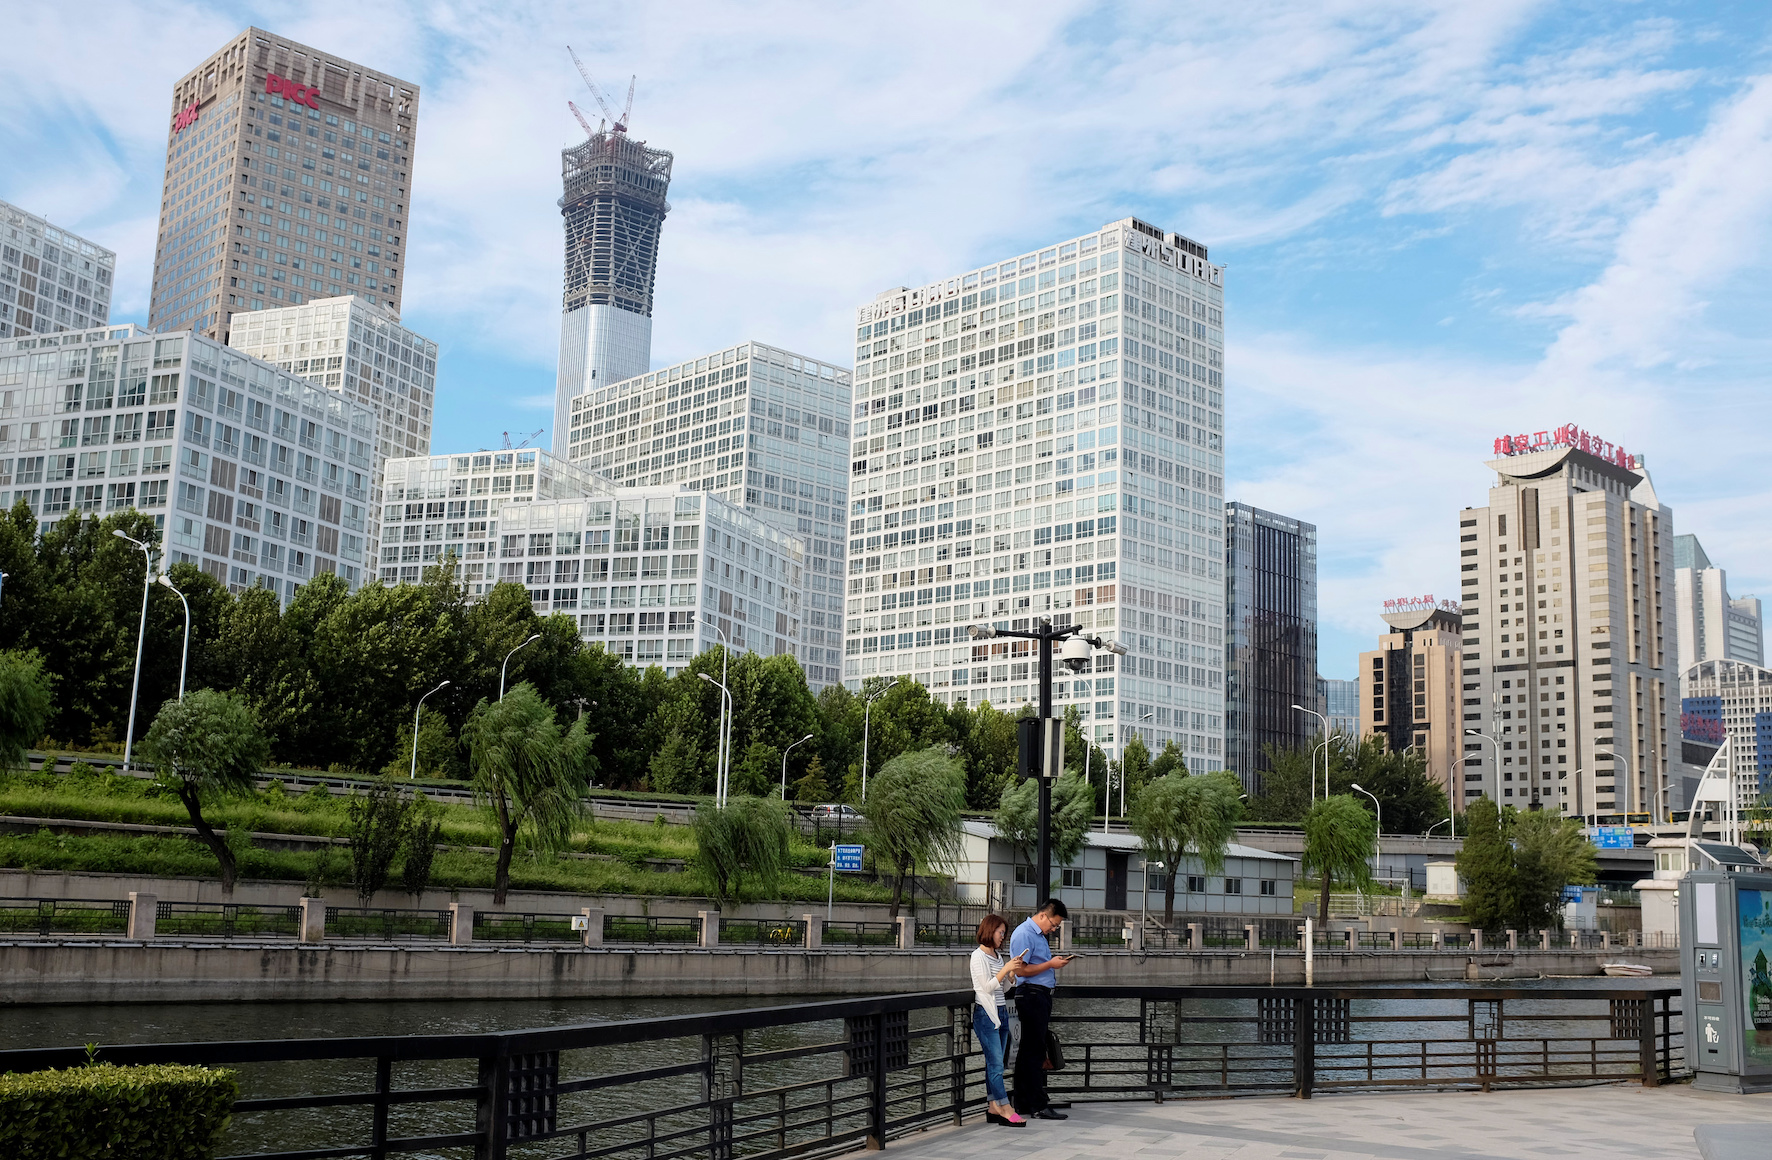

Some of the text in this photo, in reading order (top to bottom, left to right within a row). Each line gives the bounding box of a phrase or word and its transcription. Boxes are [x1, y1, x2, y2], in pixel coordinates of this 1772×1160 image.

[265, 72, 321, 110] PICC
[1124, 228, 1222, 288] 建外SOHO
[857, 278, 960, 325] 建外SOHO
[1493, 426, 1570, 455] 航空工业
